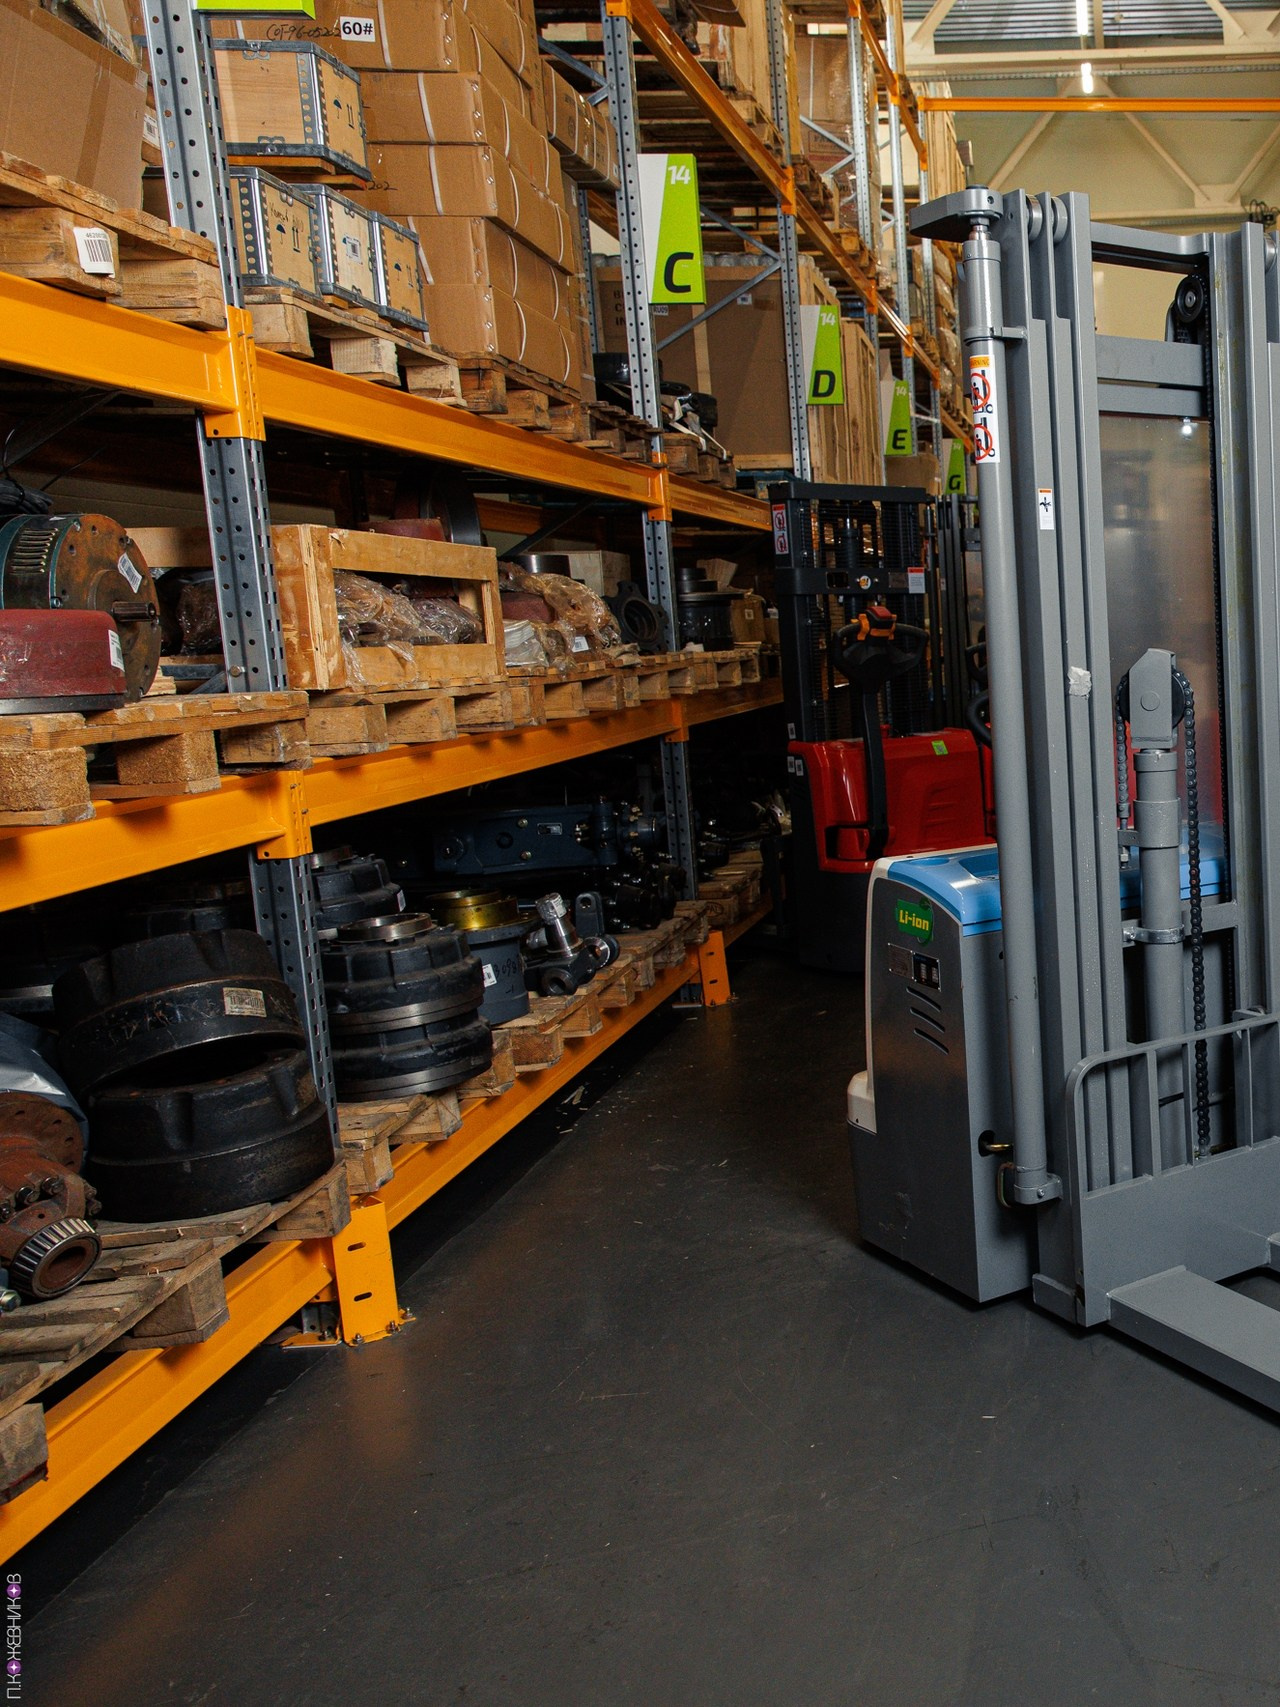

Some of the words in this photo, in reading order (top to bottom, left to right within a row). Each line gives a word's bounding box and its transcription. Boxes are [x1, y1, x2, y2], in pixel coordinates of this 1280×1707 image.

[342, 21, 373, 35] 60#
[668, 165, 691, 185] 14
[664, 252, 694, 293] C
[820, 312, 836, 326] 14
[812, 370, 836, 398] D
[896, 386, 907, 396] 14
[892, 429, 907, 450] E
[949, 475, 961, 490] G
[899, 909, 929, 931] Li-ion
